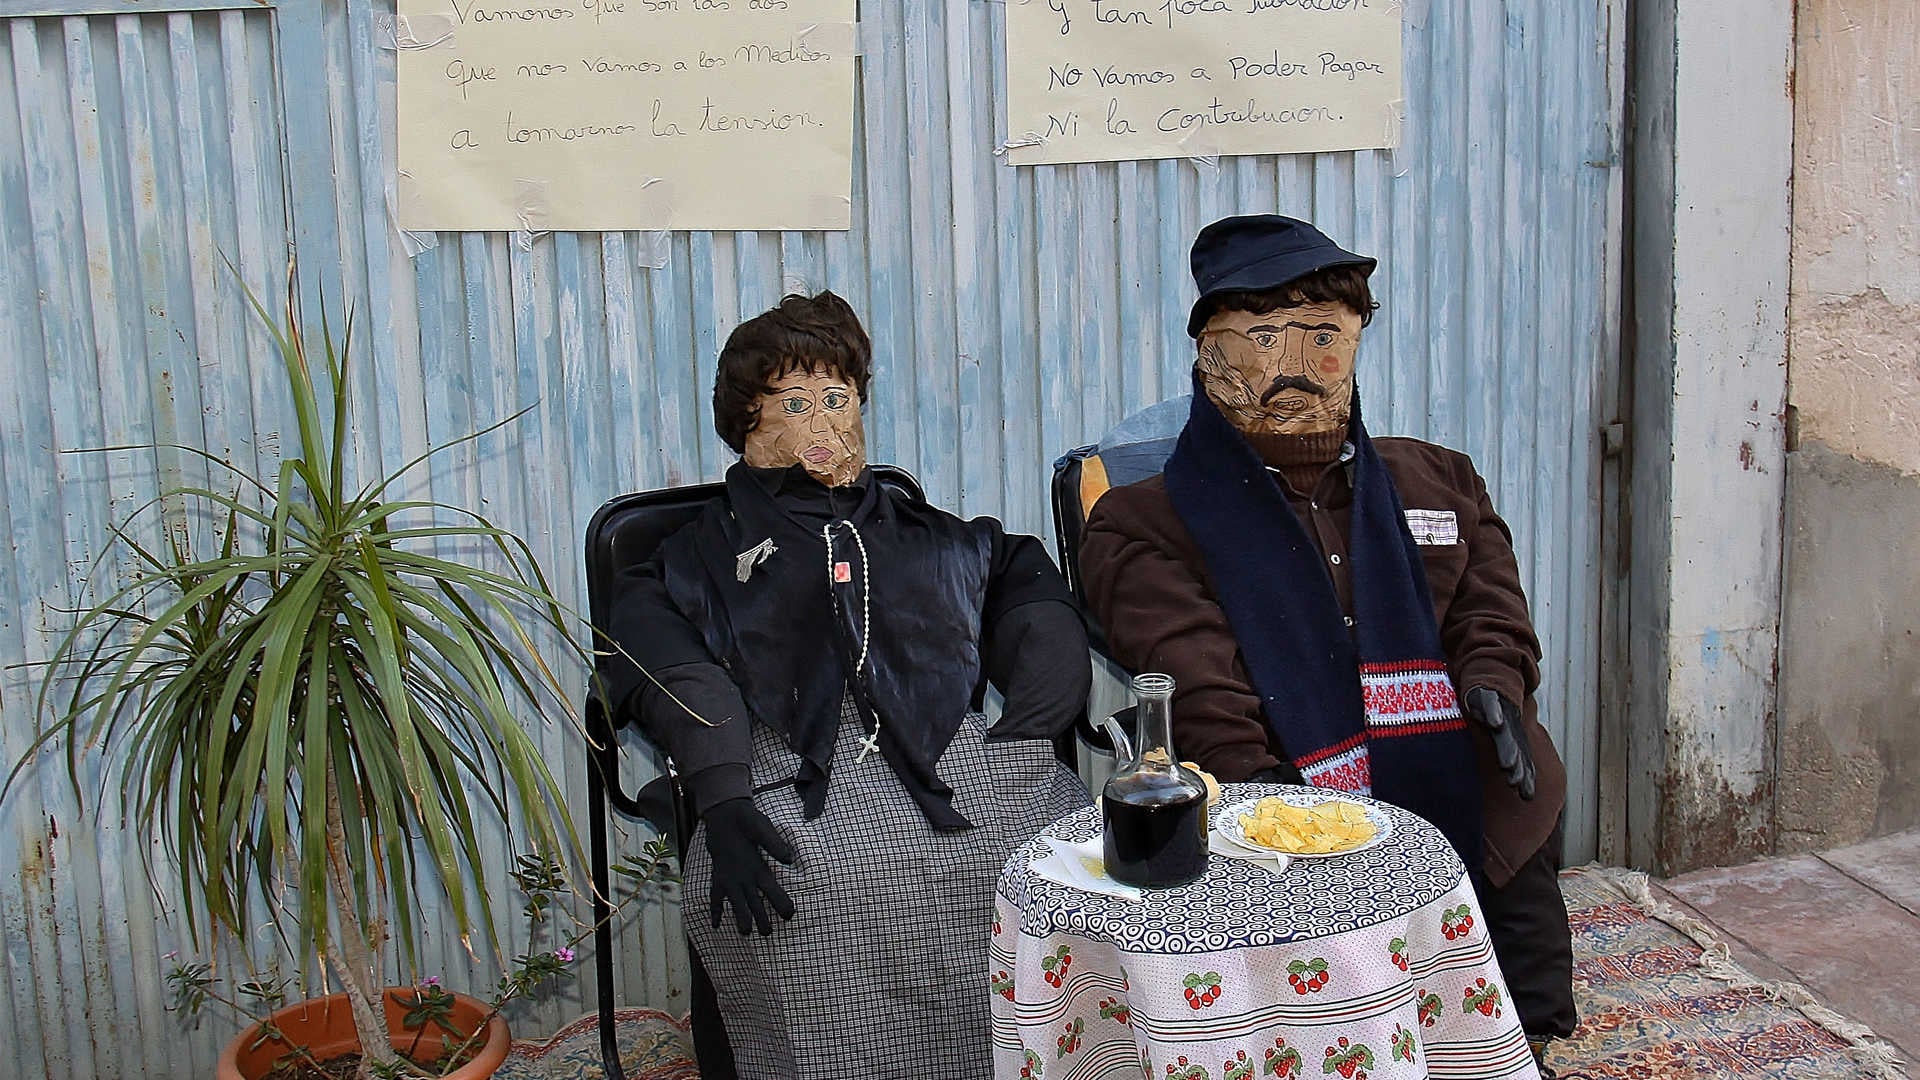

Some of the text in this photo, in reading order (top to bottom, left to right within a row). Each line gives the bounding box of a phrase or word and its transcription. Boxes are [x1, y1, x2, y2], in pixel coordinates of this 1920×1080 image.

[452, 0, 574, 25] Vamonos
[1090, 0, 1153, 24] tan
[517, 64, 568, 77] nos
[673, 61, 688, 71] a
[699, 51, 726, 68] los
[1190, 67, 1212, 81] a
[1228, 49, 1309, 80] Poder
[1317, 52, 1385, 81] Pagar
[451, 96, 824, 149] a tomarnos la tension.
[1045, 111, 1079, 138] Ni
[1106, 98, 1137, 135] la
